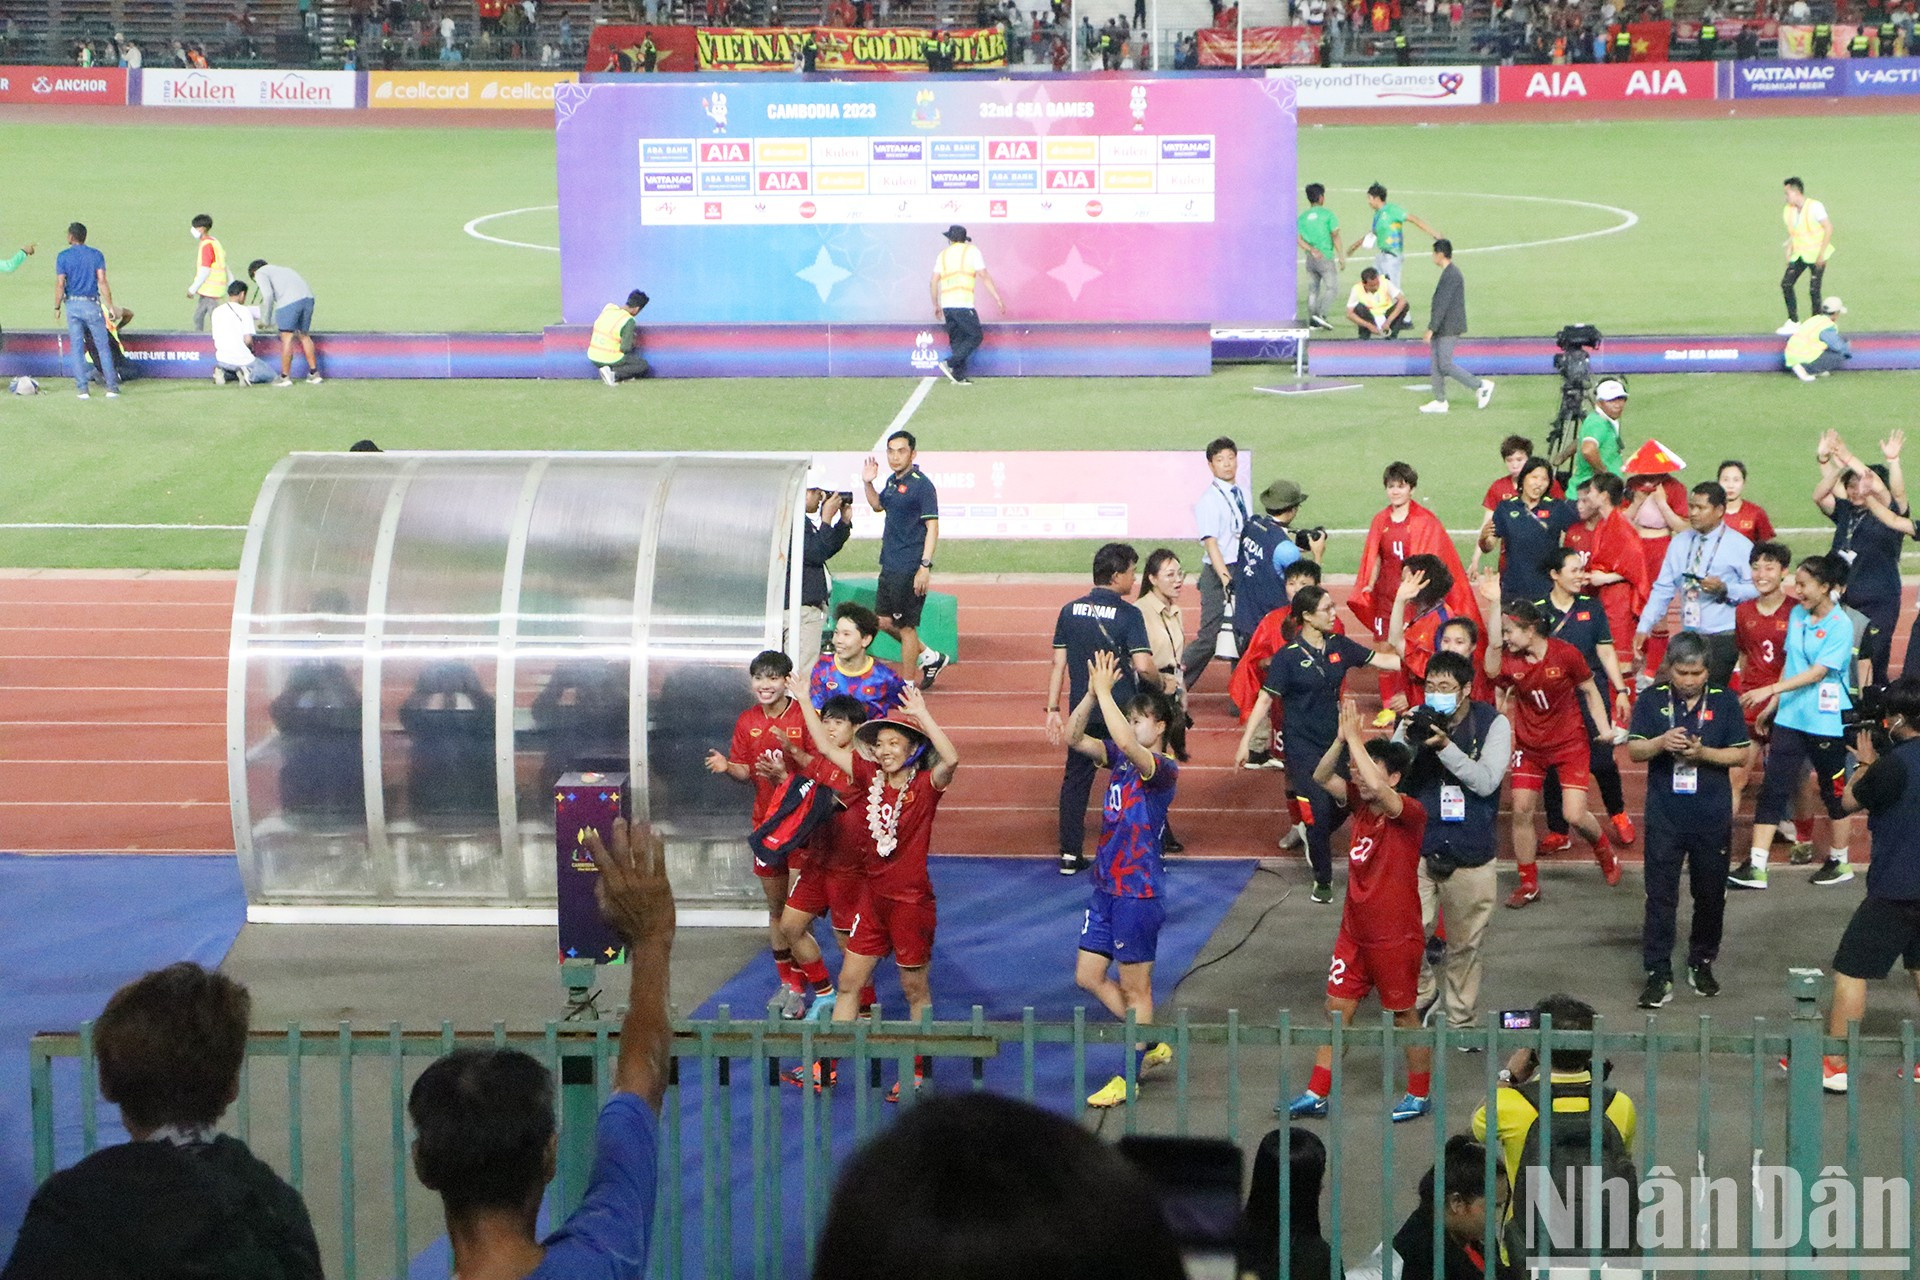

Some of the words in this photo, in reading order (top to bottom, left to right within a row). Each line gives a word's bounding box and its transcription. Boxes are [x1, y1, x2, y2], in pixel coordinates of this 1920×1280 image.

[1625, 69, 1688, 95] AIA
[1742, 65, 1835, 82] VATTANAC
[1855, 69, 1920, 84] V-ACTI
[55, 79, 107, 92] ANCHOR
[174, 80, 235, 99] Kulen
[271, 81, 331, 100] Kulen
[394, 82, 469, 99] cellcard
[1526, 71, 1587, 97] AIA
[1751, 82, 1796, 91] PREMIUM
[1799, 80, 1826, 90] BEER
[767, 103, 840, 120] CAMBODIA
[842, 103, 877, 120] 2023
[978, 102, 1014, 119] 32nd
[1015, 102, 1043, 119] SEA
[1045, 102, 1096, 119] GAMES
[707, 144, 744, 161] AIA
[874, 144, 921, 153] VATTANAC
[994, 142, 1032, 159] AIA
[1163, 143, 1210, 152] VATTANAC
[646, 176, 692, 185] VATTANAC
[765, 173, 802, 189] AIA
[932, 173, 979, 182] VATTANAC
[1052, 171, 1089, 188] AIA
[1393, 541, 1404, 561] 4
[1374, 617, 1383, 636] 4
[1762, 639, 1774, 663] 3
[1531, 689, 1549, 710] 11
[881, 803, 893, 829] 9
